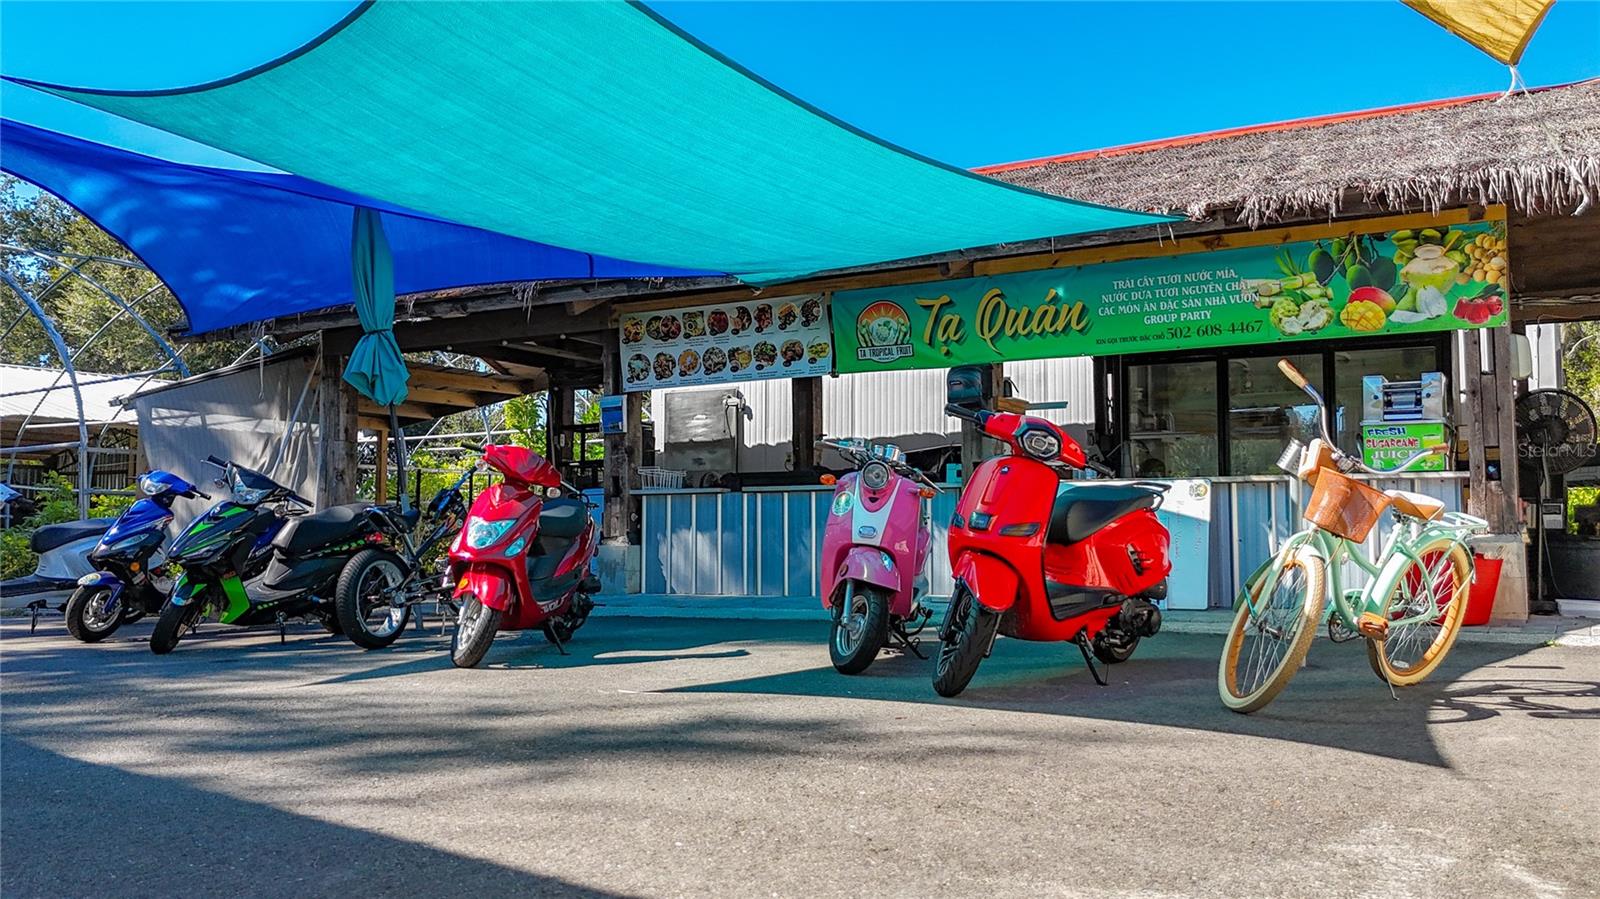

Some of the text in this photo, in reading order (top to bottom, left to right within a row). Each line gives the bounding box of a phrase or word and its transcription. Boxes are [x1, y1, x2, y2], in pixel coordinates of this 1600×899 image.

[915, 287, 1089, 357] Tạ Quán
[1144, 310, 1212, 325] GROUP PARTY
[1367, 426, 1407, 437] FRESH
[1366, 437, 1419, 449] SUGARCANE
